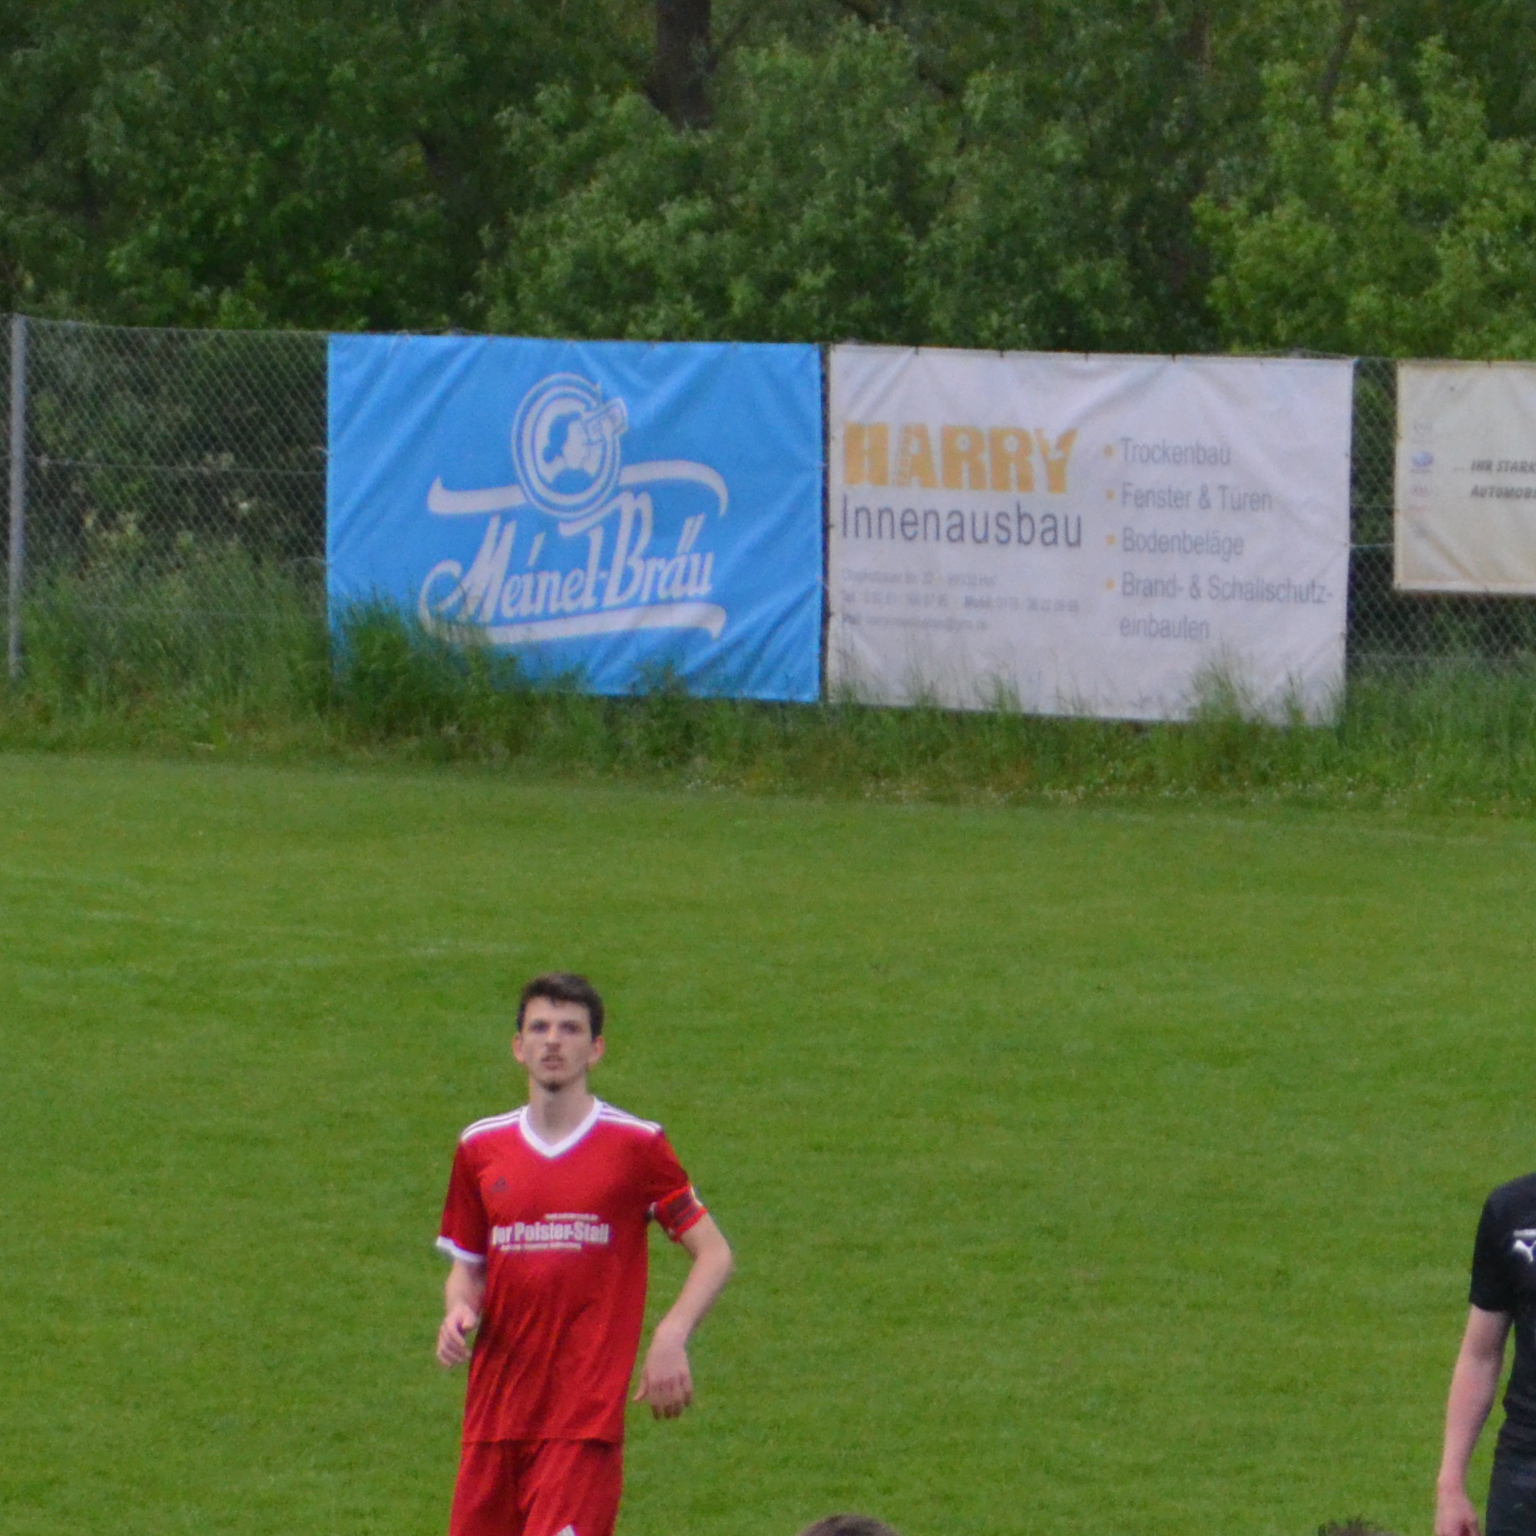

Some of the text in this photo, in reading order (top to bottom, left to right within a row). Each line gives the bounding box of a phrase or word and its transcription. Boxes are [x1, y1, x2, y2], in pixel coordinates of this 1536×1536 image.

[843, 422, 1079, 494] HARRY
[1120, 437, 1231, 466] Trockenbau
[1121, 482, 1272, 512] Fenster & Türen
[841, 495, 1083, 549] Innenausbau
[1122, 526, 1244, 562] Bodenbeläge
[420, 490, 716, 628] Meinel-Bräu
